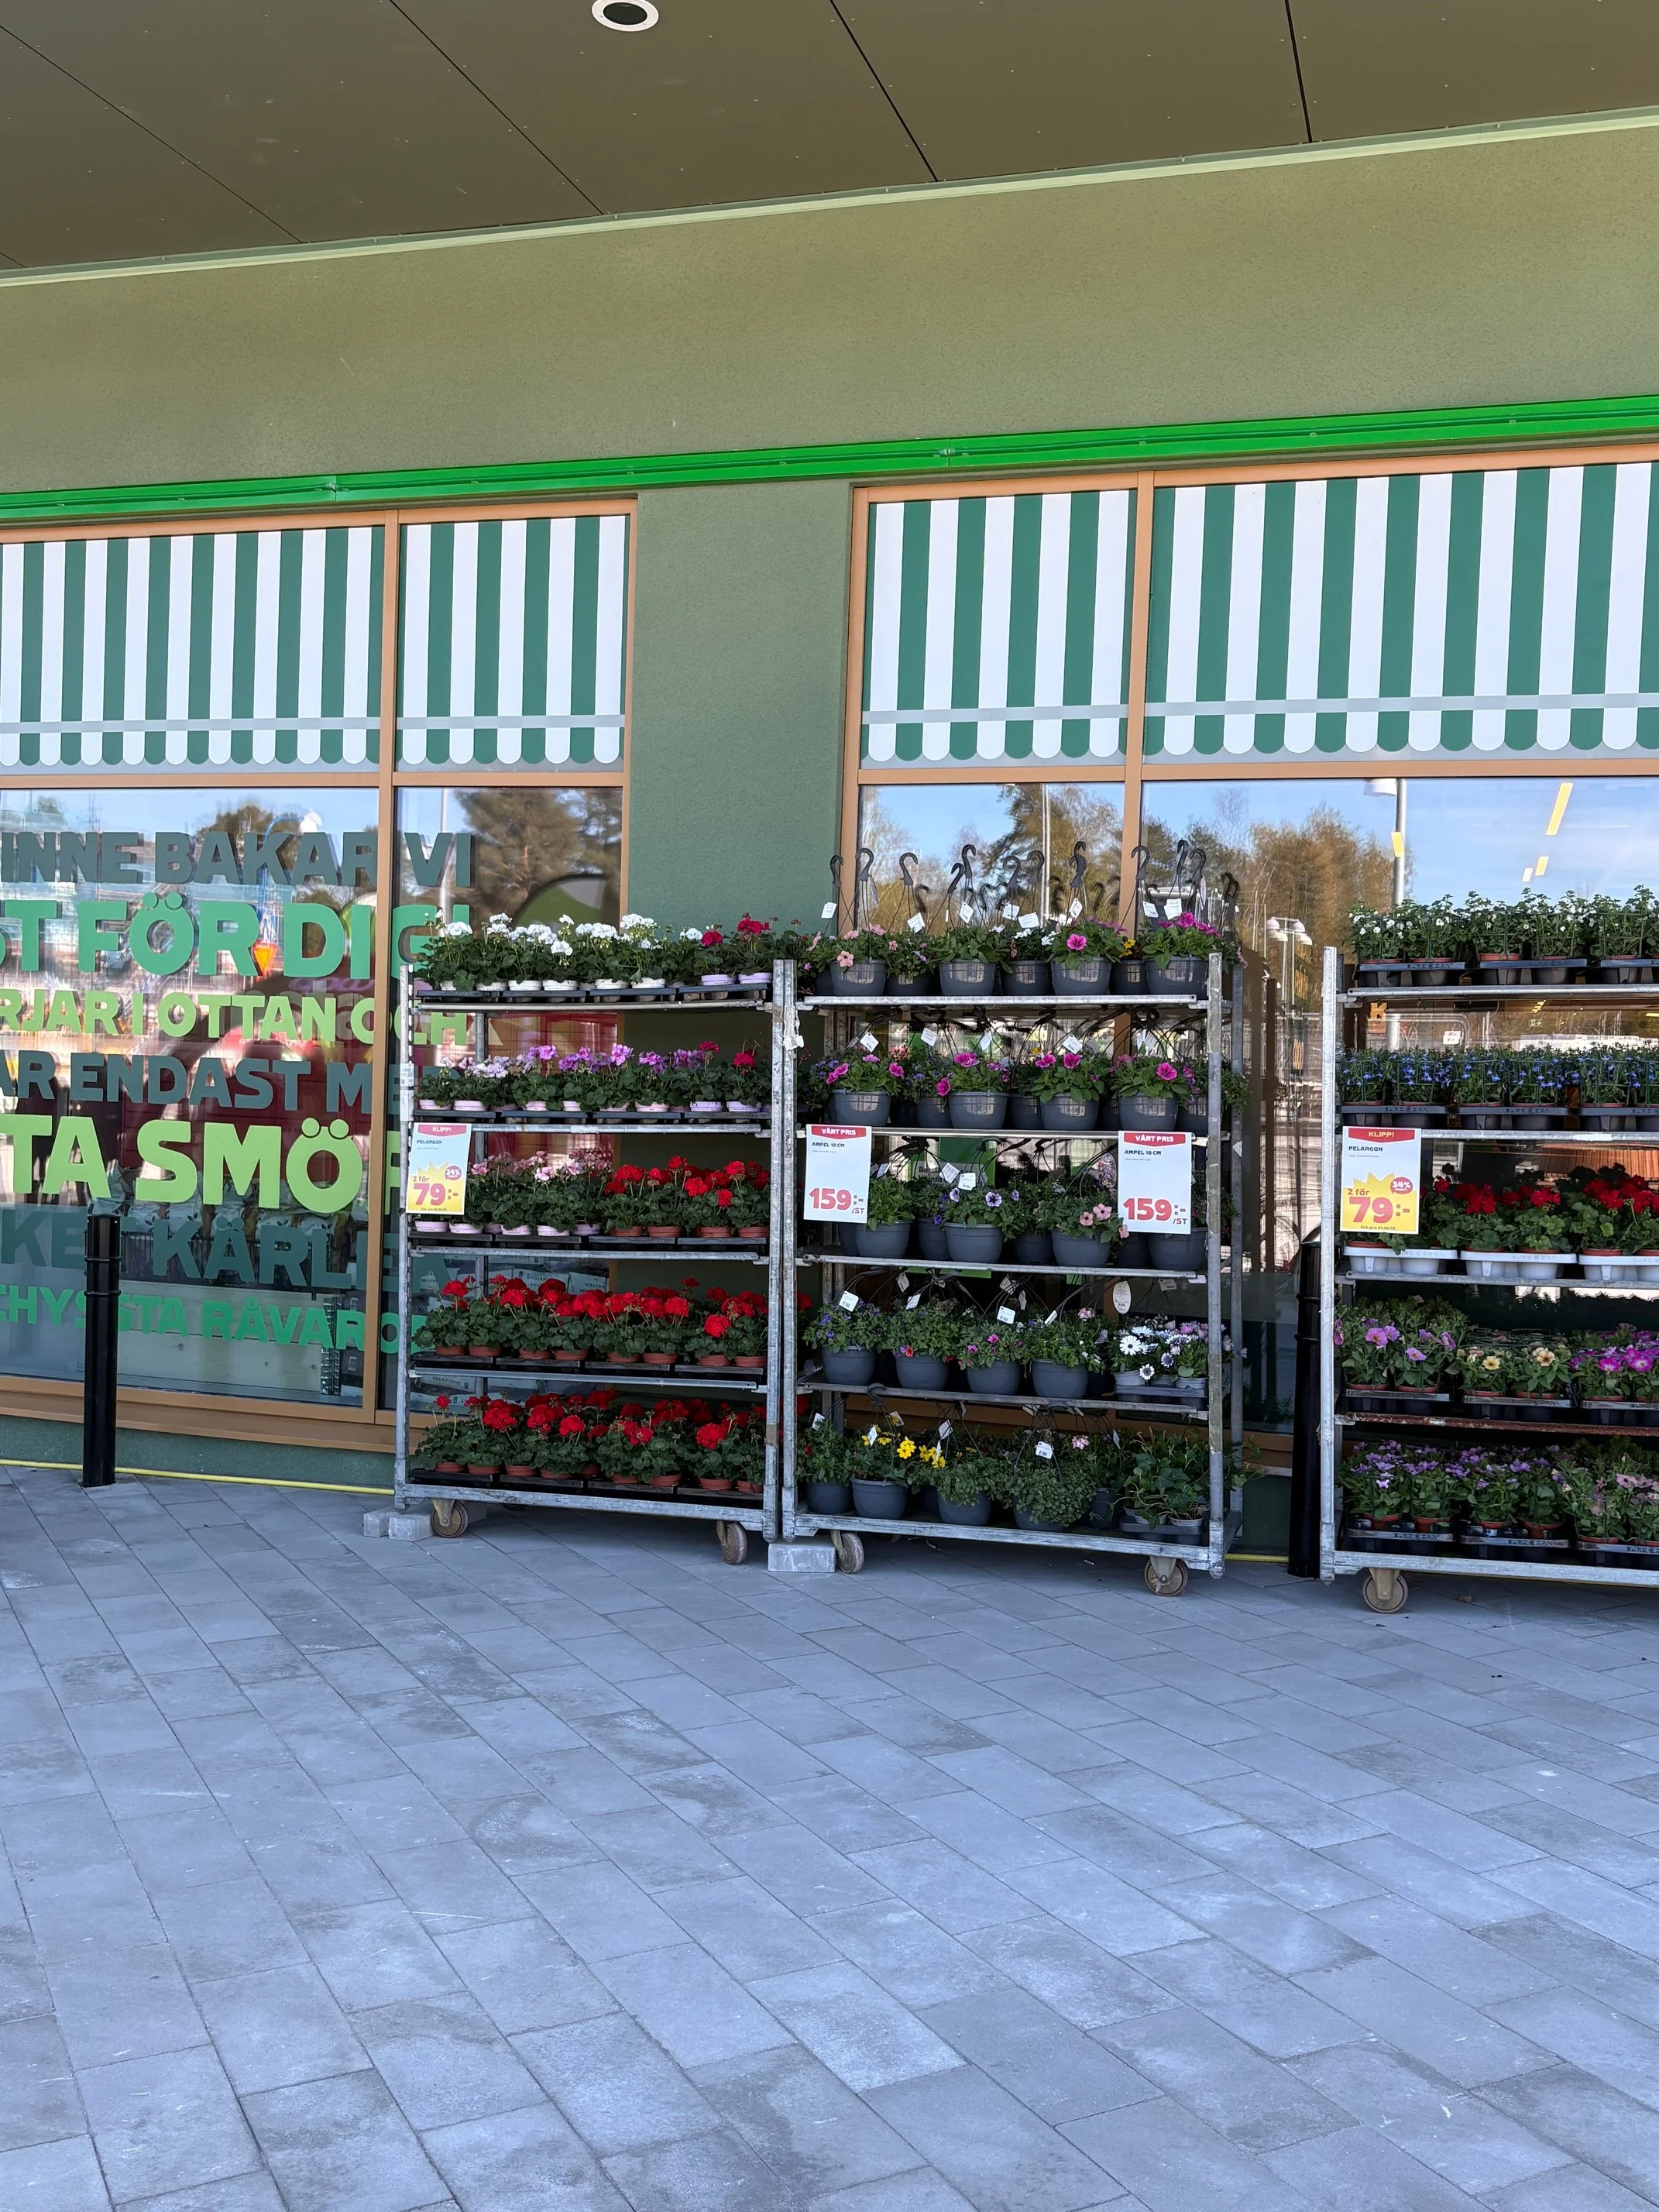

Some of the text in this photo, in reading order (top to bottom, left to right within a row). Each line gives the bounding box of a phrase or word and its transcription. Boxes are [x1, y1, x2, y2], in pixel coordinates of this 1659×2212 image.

[2, 831, 471, 887] INNE BAKAR VI
[0, 899, 58, 972] T
[77, 891, 260, 976] FÖR
[132, 992, 144, 1036] I
[157, 991, 335, 1042] OTTAN
[70, 1052, 311, 1111] ENDAST
[326, 1061, 462, 1115] ME
[1392, 1180, 1411, 1189] 34%
